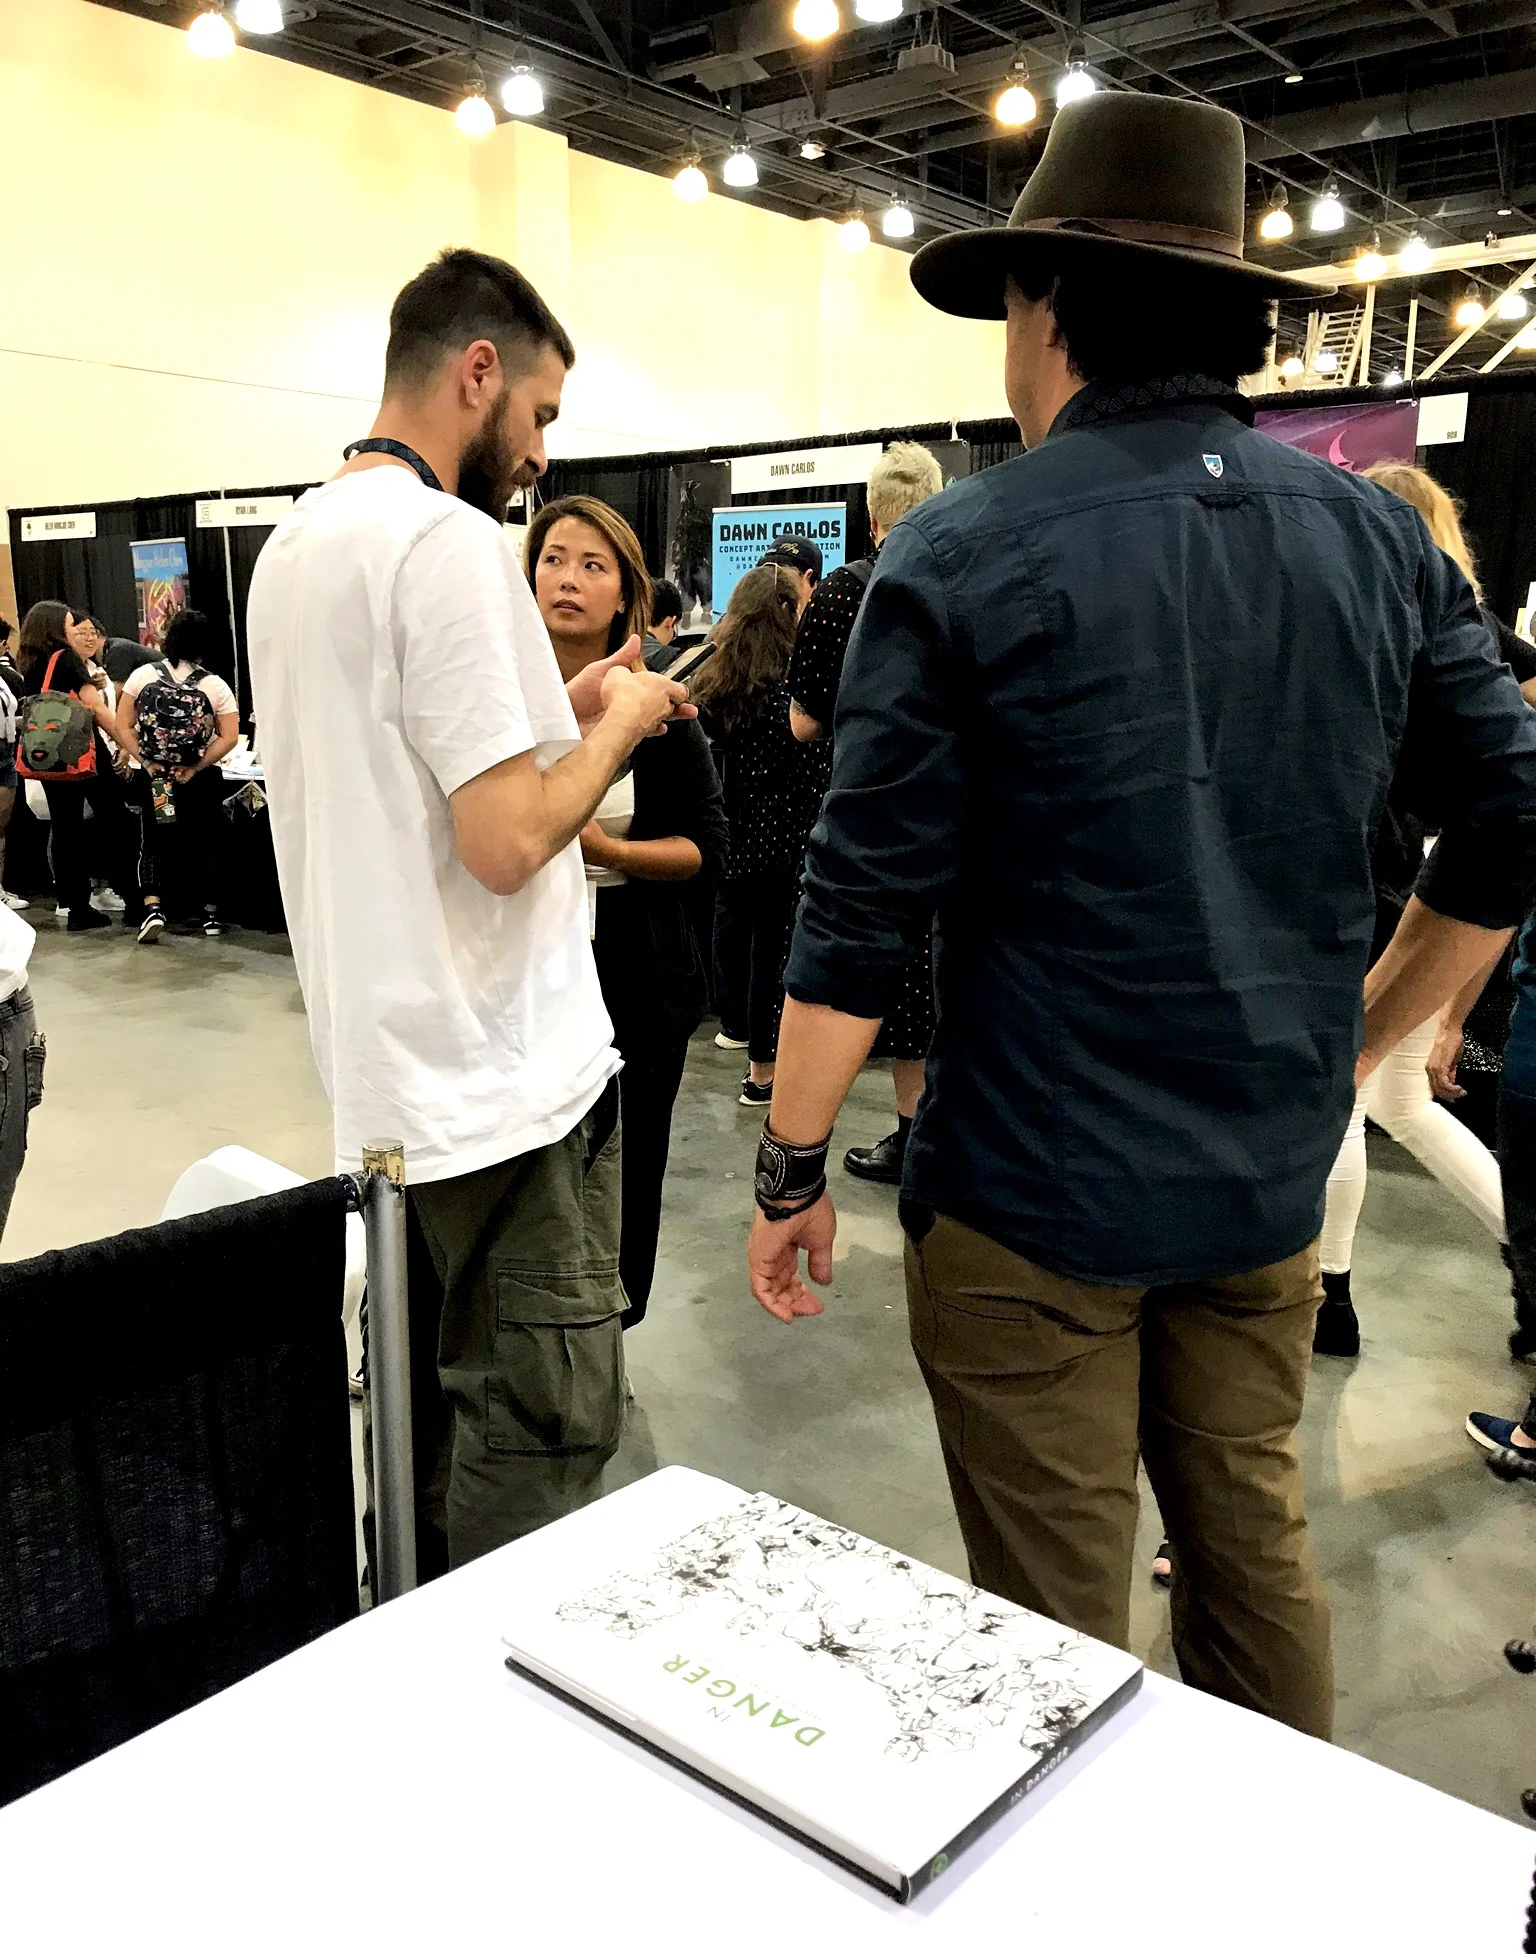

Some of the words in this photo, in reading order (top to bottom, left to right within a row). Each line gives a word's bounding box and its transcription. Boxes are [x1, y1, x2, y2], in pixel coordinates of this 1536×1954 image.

[770, 464, 790, 477] DAWN
[791, 461, 815, 475] CARLOS
[719, 523, 768, 542] DAWN
[771, 520, 841, 540] CARLOS
[719, 544, 754, 554] CONCEPT
[662, 1654, 826, 1747] DANGER
[705, 1706, 732, 1722] IN
[1025, 1746, 1069, 1792] DANGER
